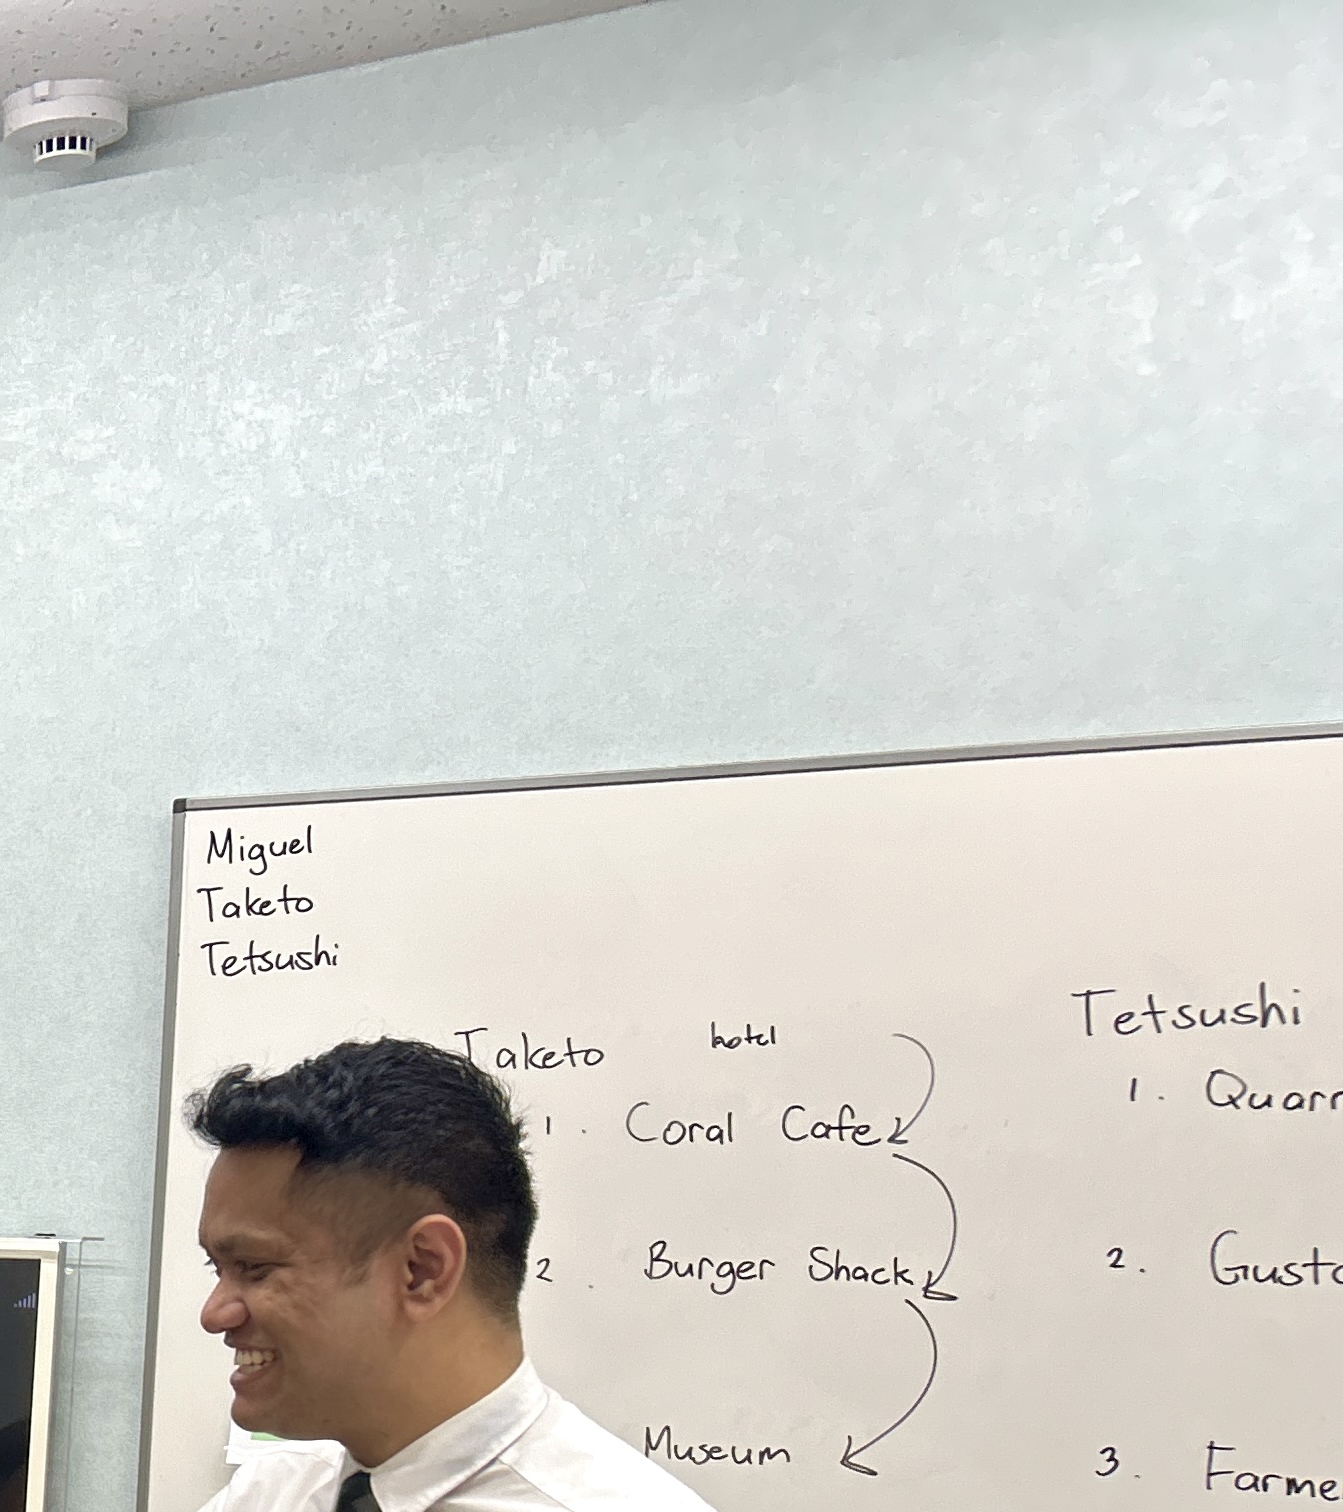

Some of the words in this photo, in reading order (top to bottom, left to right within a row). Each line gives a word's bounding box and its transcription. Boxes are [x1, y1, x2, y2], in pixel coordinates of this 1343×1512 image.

[206, 825, 313, 876] Miguel
[197, 884, 314, 922] Taketo
[201, 934, 340, 978] Tetsushi
[1071, 981, 1302, 1037] Tetsushi
[454, 1027, 604, 1070] Taketo
[711, 1021, 777, 1050] hotel
[625, 1101, 734, 1146] Coral
[781, 1104, 881, 1146] Cafe
[643, 1240, 776, 1296] Burger
[807, 1246, 914, 1287] Shack
[644, 1425, 791, 1465] Museum
